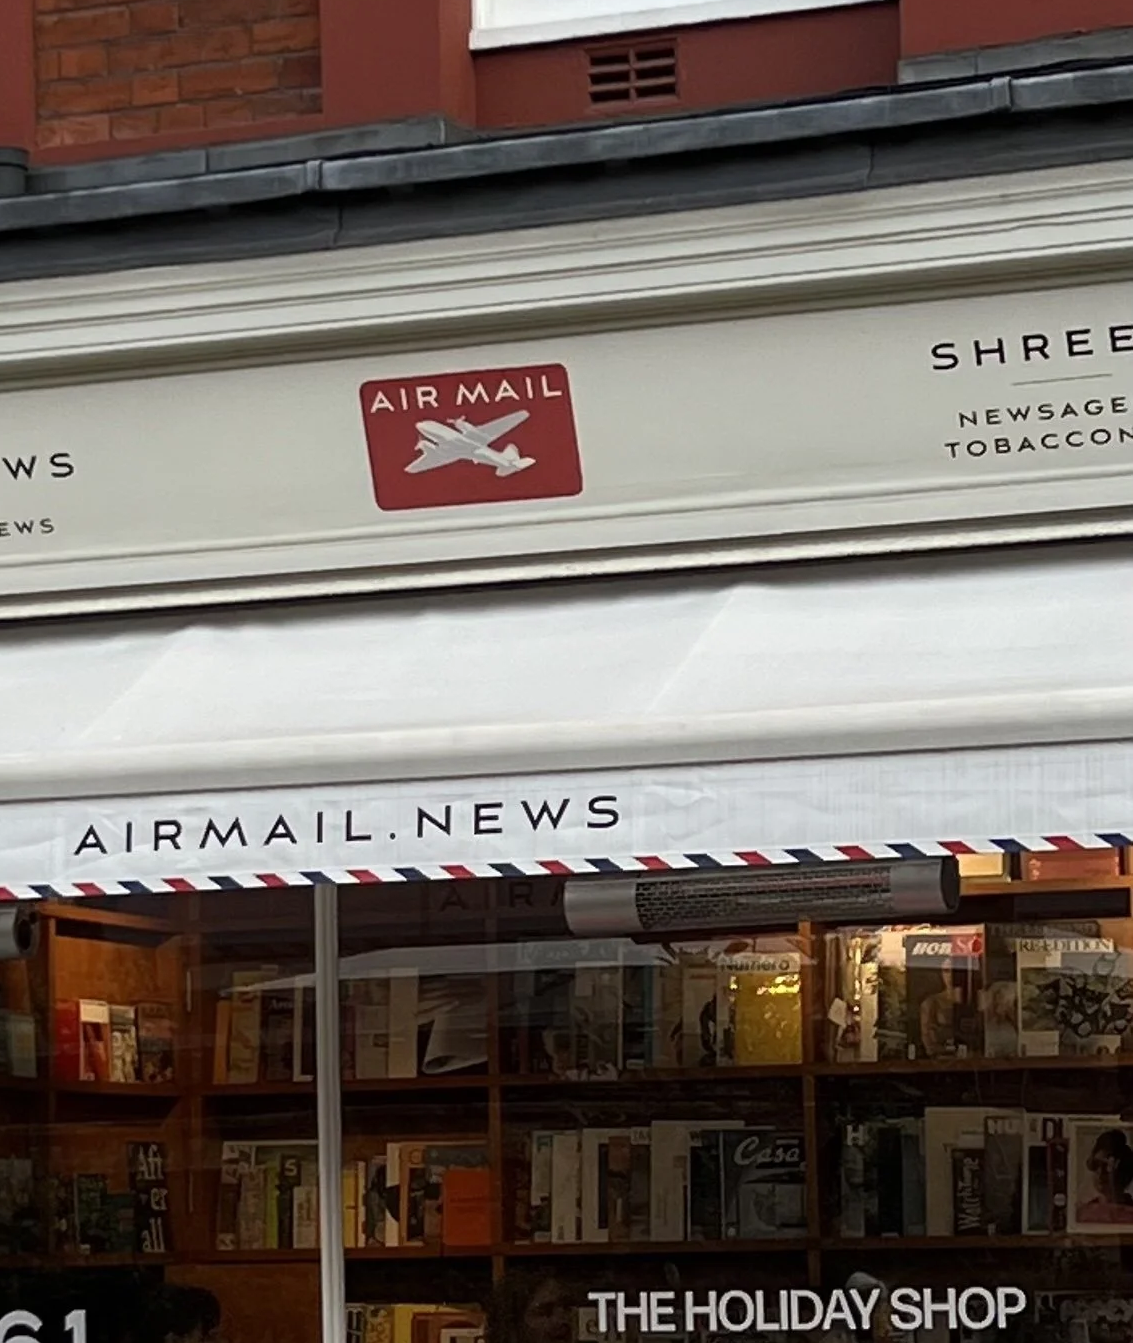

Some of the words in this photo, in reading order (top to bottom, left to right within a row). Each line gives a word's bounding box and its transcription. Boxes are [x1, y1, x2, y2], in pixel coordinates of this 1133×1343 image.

[931, 324, 1133, 370] SHREE
[370, 386, 439, 413] AIR
[455, 374, 563, 406] MAIL
[958, 396, 1128, 429] NEWSAGE
[944, 427, 1133, 458] TOBACCON
[73, 794, 621, 856] AIRMAIL.NEWS
[732, 1135, 801, 1166] Casa
[587, 1291, 677, 1333] THE
[685, 1289, 881, 1333] HOLIDAY
[890, 1286, 1028, 1331] SHOP
